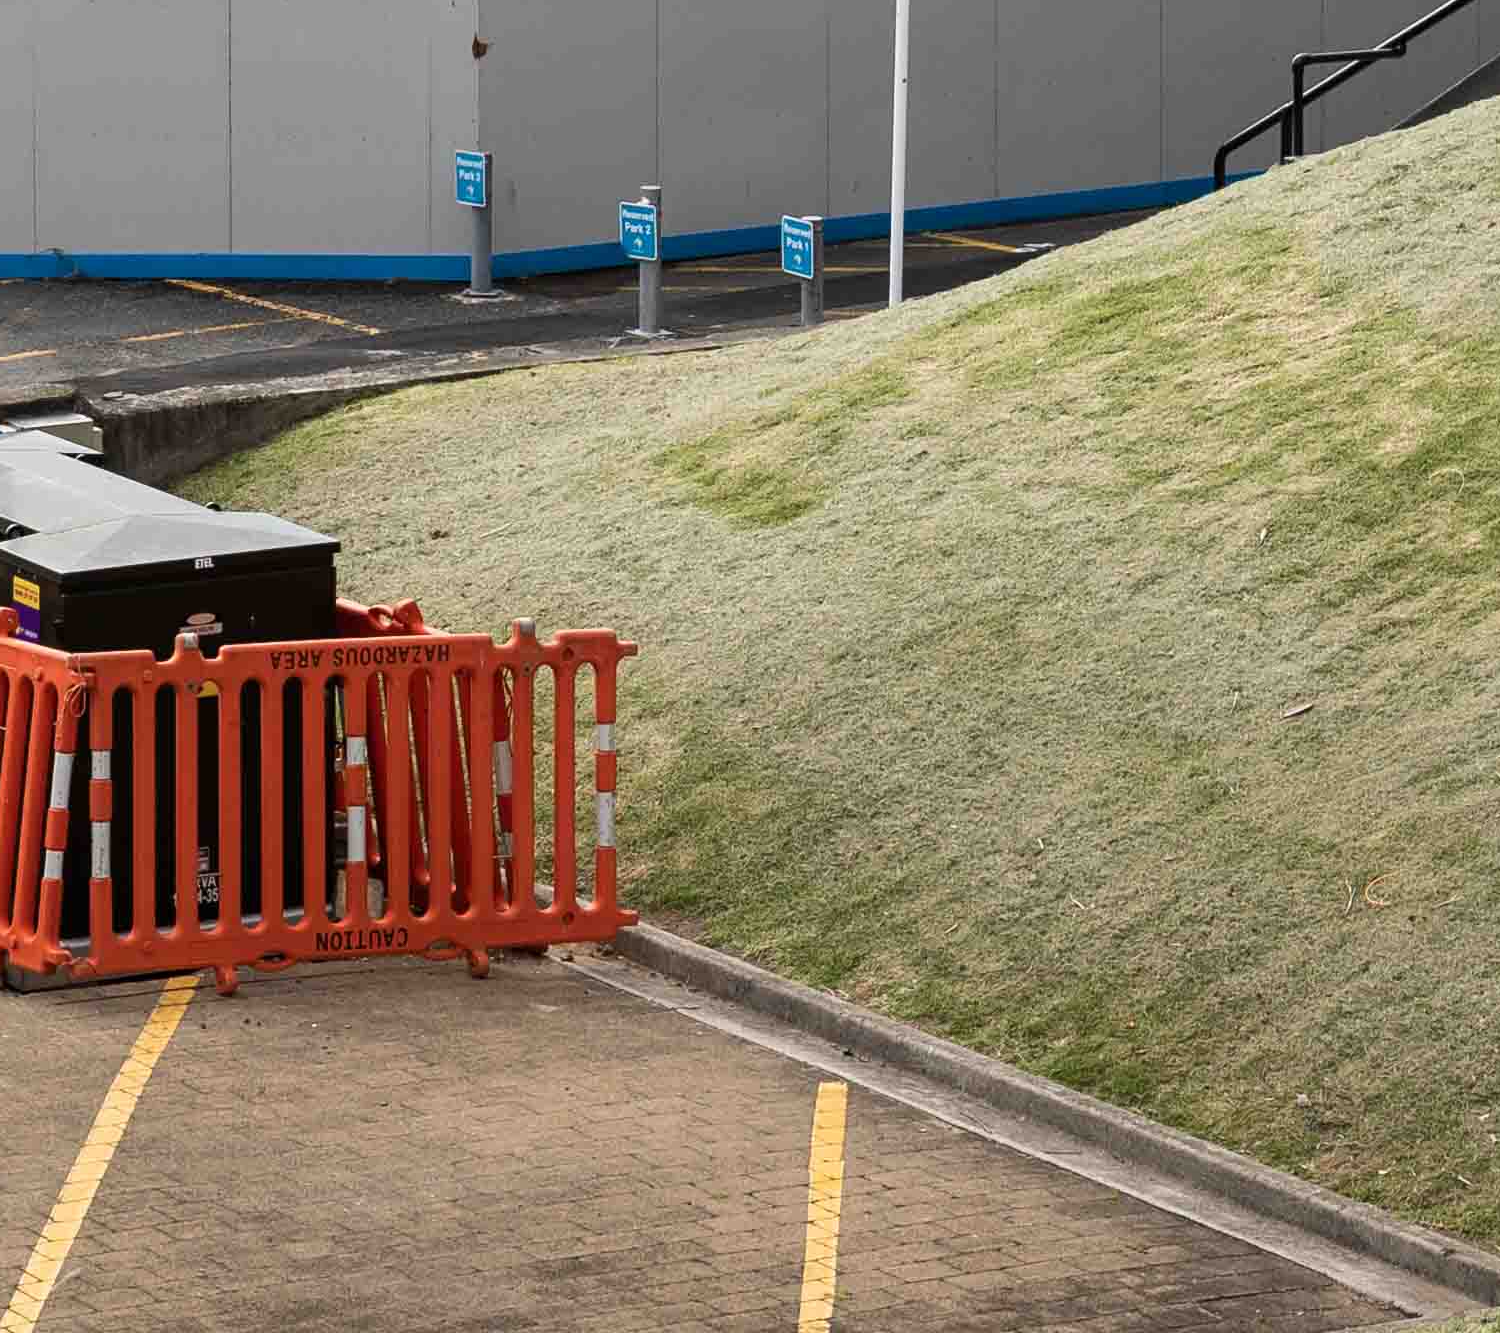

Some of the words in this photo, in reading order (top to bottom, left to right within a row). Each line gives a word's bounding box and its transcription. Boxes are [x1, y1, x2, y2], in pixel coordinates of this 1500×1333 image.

[459, 168, 474, 181] Park
[625, 221, 643, 235] Park
[786, 236, 803, 250] Park
[194, 556, 215, 570] ETEL
[269, 648, 323, 670] AREA
[332, 644, 450, 667] HAZARDOUS
[315, 927, 409, 951] CAUTION
